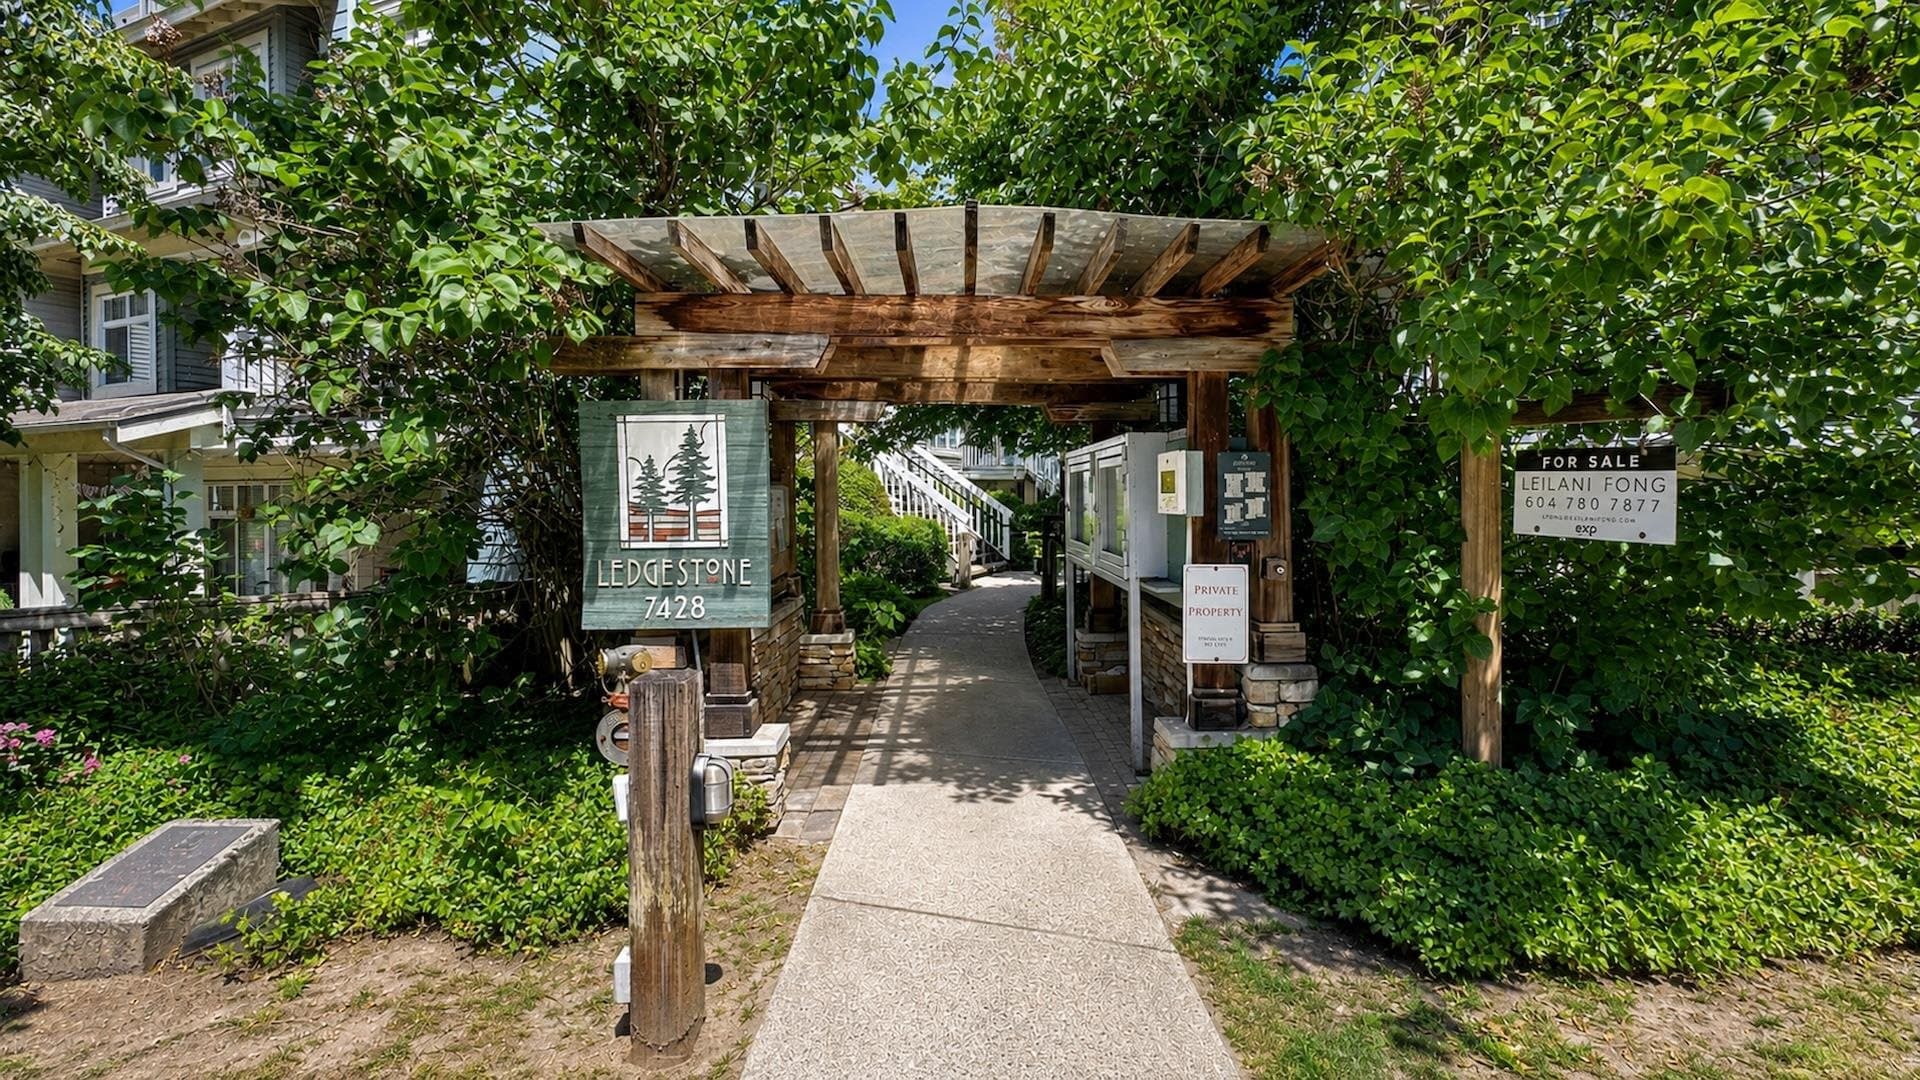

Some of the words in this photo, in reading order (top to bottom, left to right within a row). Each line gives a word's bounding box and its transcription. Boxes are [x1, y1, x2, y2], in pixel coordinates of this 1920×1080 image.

[1542, 456, 1578, 470] FOR
[1588, 454, 1640, 469] SALE
[1521, 476, 1592, 492] LEILANI
[1604, 476, 1666, 493] FONG
[1525, 496, 1557, 509] 604
[1566, 497, 1600, 511] 780
[1610, 498, 1661, 513] 7877
[1575, 524, 1598, 537] exp
[597, 558, 752, 588] LEDGESTONE
[1194, 585, 1239, 595] PRIVATE
[644, 595, 706, 620] 7428
[1188, 607, 1243, 617] PROPERTY
